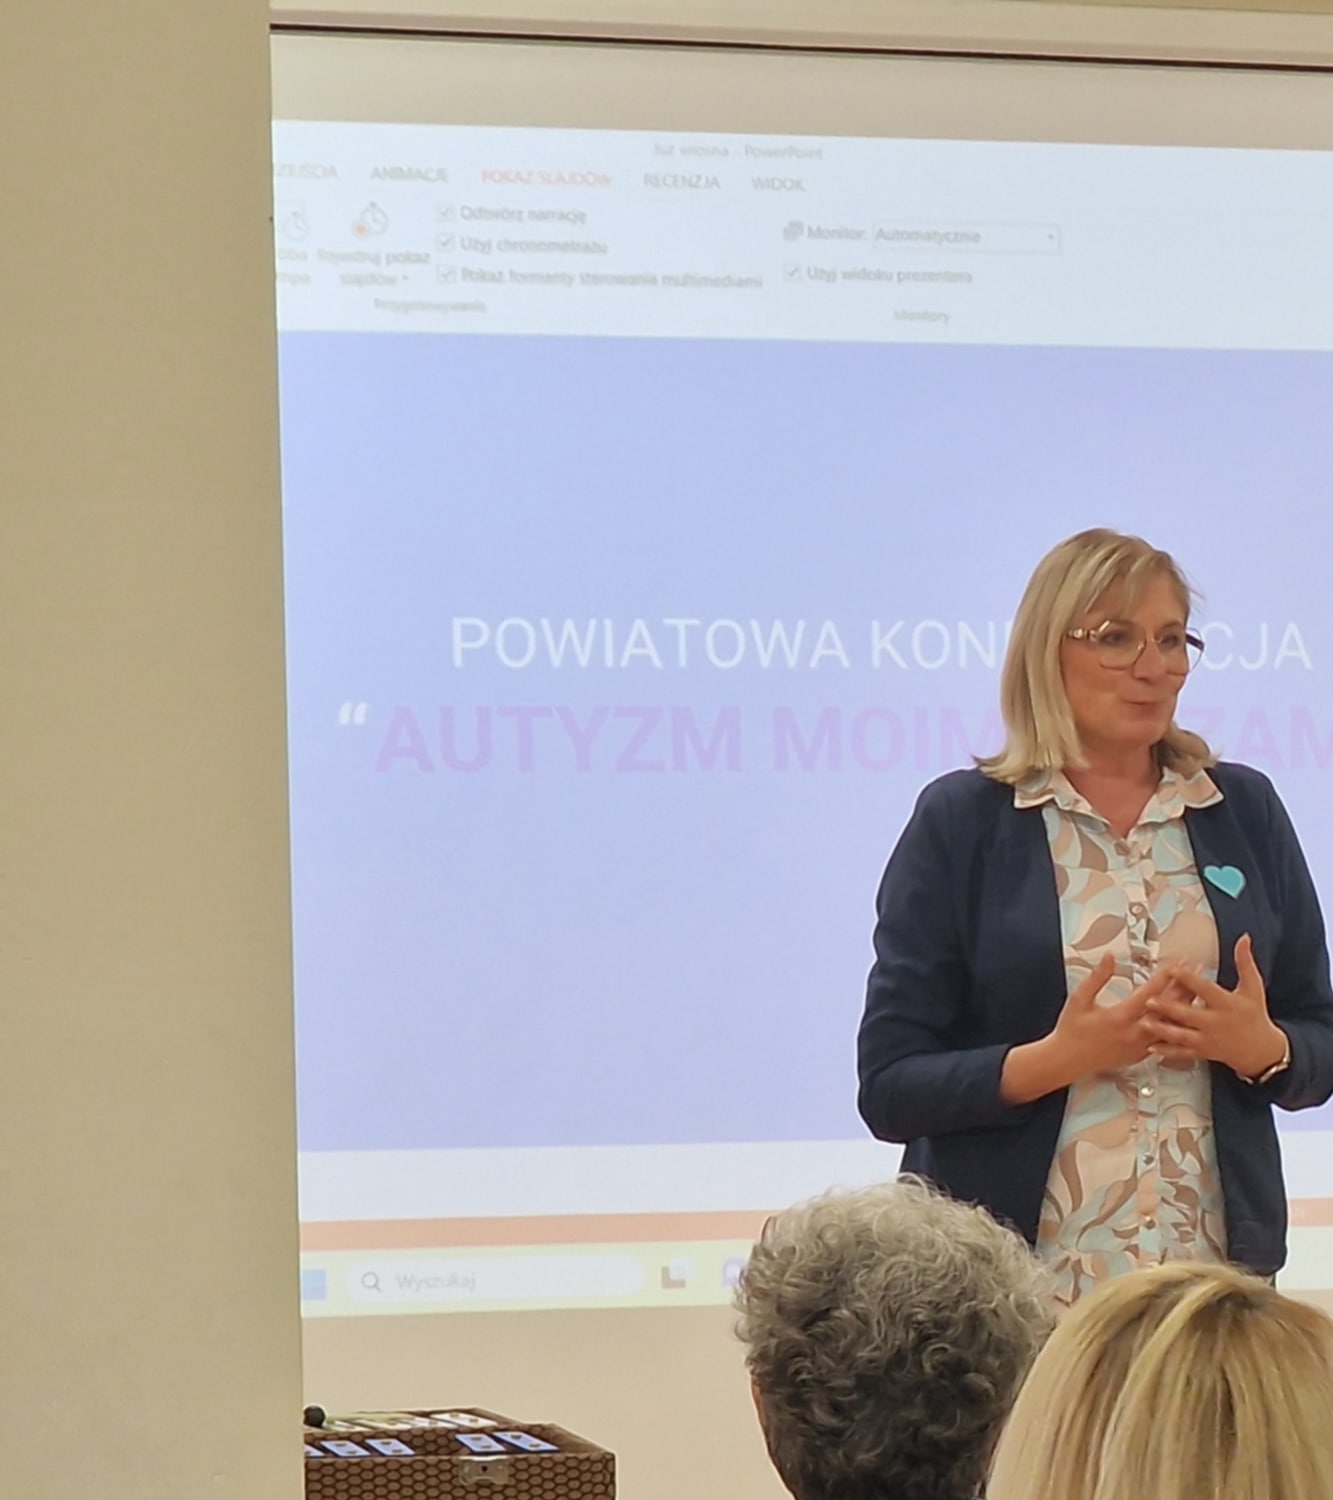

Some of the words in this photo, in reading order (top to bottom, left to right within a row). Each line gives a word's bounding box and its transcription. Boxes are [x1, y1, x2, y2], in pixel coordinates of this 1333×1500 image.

[745, 145, 822, 158] PowerPoint
[370, 166, 448, 183] ANIMACJE
[643, 172, 721, 190] RECENZJA
[751, 176, 806, 191] WIDOK
[875, 227, 981, 246] Automatycznie
[450, 617, 851, 670] POWIATOWA
[870, 618, 1313, 671] KONCJA
[772, 703, 1007, 774] MOIM
[397, 1273, 476, 1293] Wyszukaj
